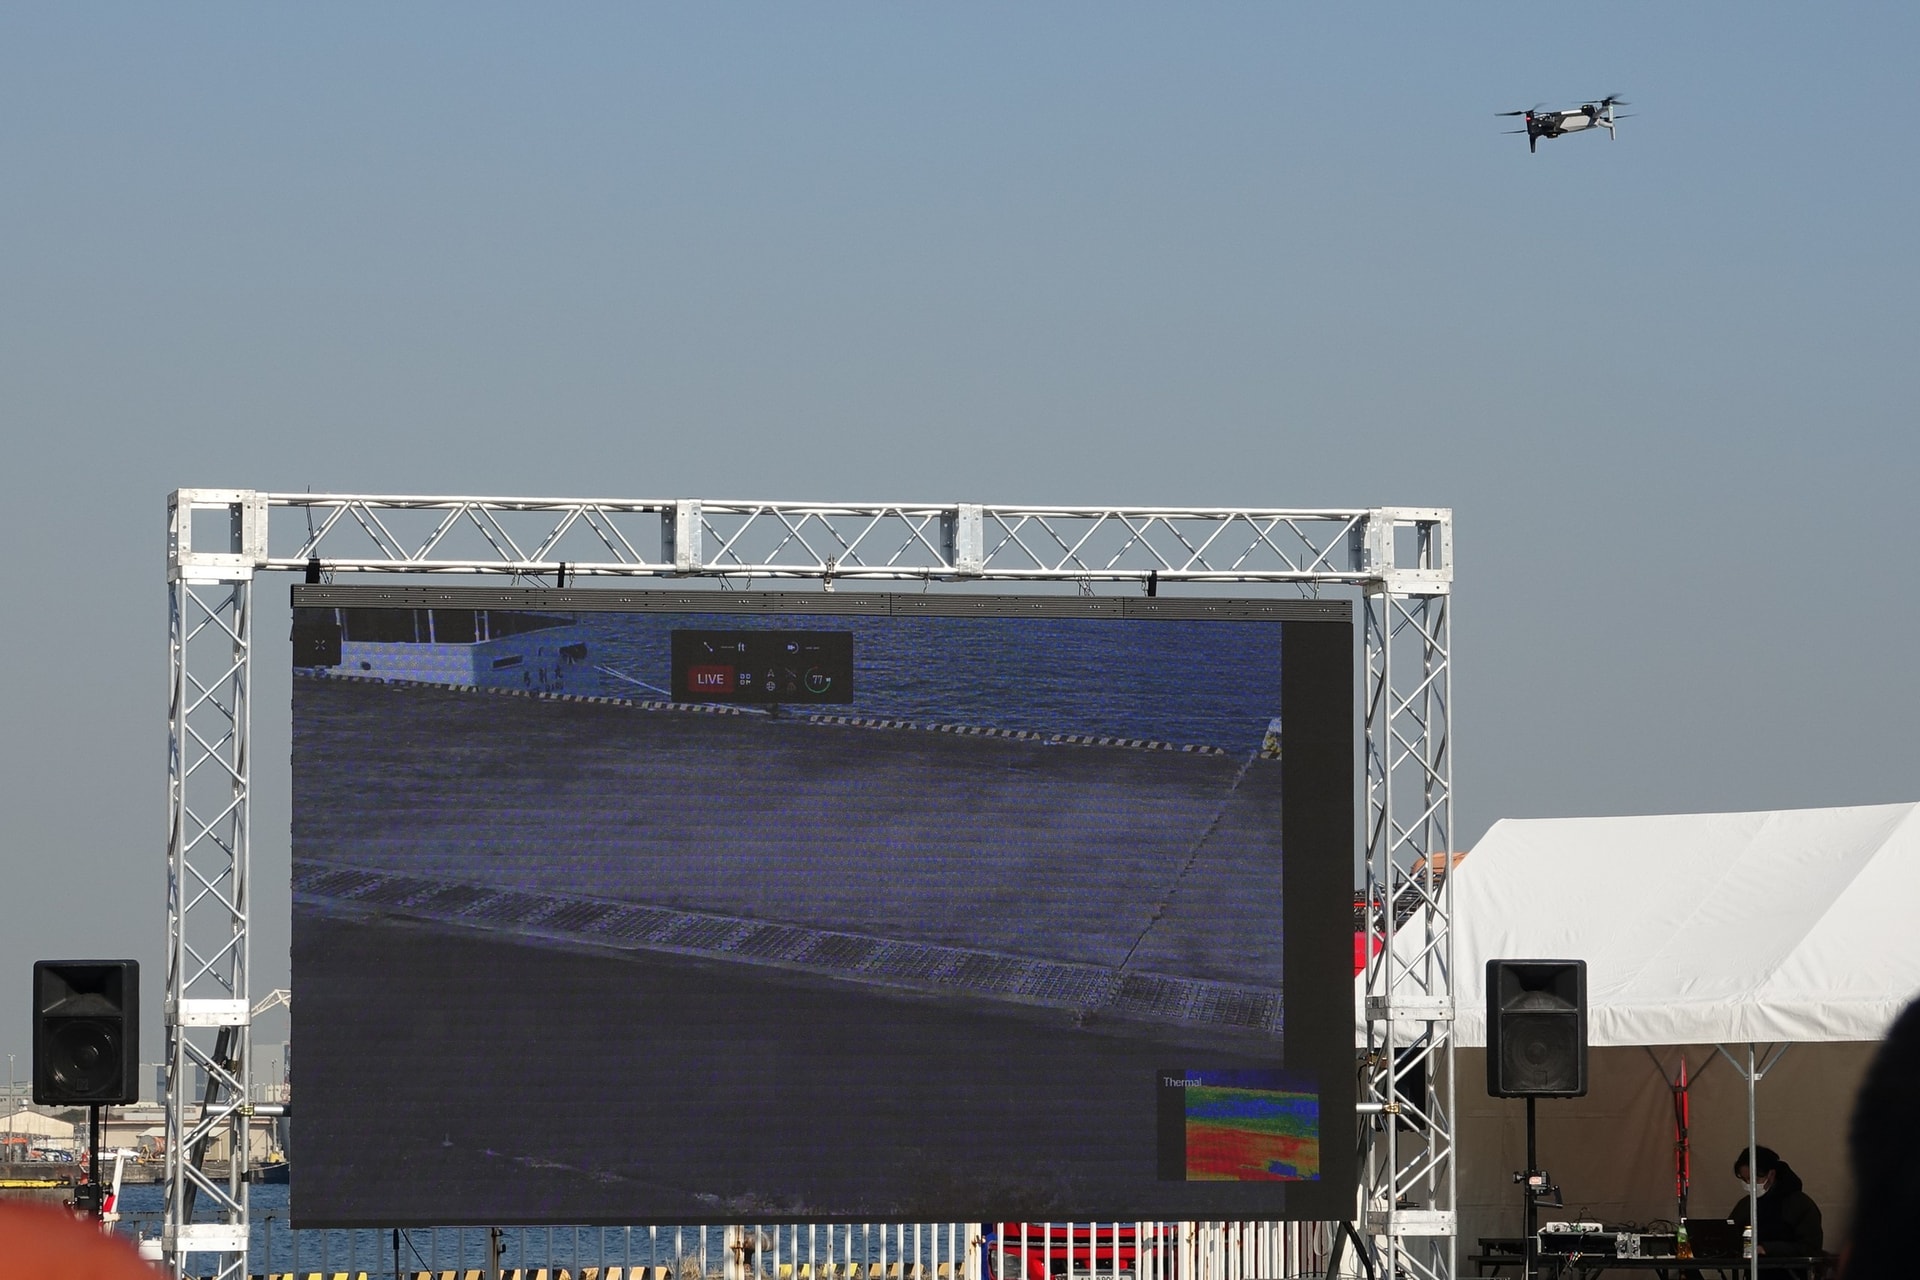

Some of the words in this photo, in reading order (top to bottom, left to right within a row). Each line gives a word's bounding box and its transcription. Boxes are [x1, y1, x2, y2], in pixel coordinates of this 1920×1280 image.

[697, 673, 724, 685] LIVE
[812, 674, 823, 685] 77
[1163, 1077, 1202, 1087] Thermal
